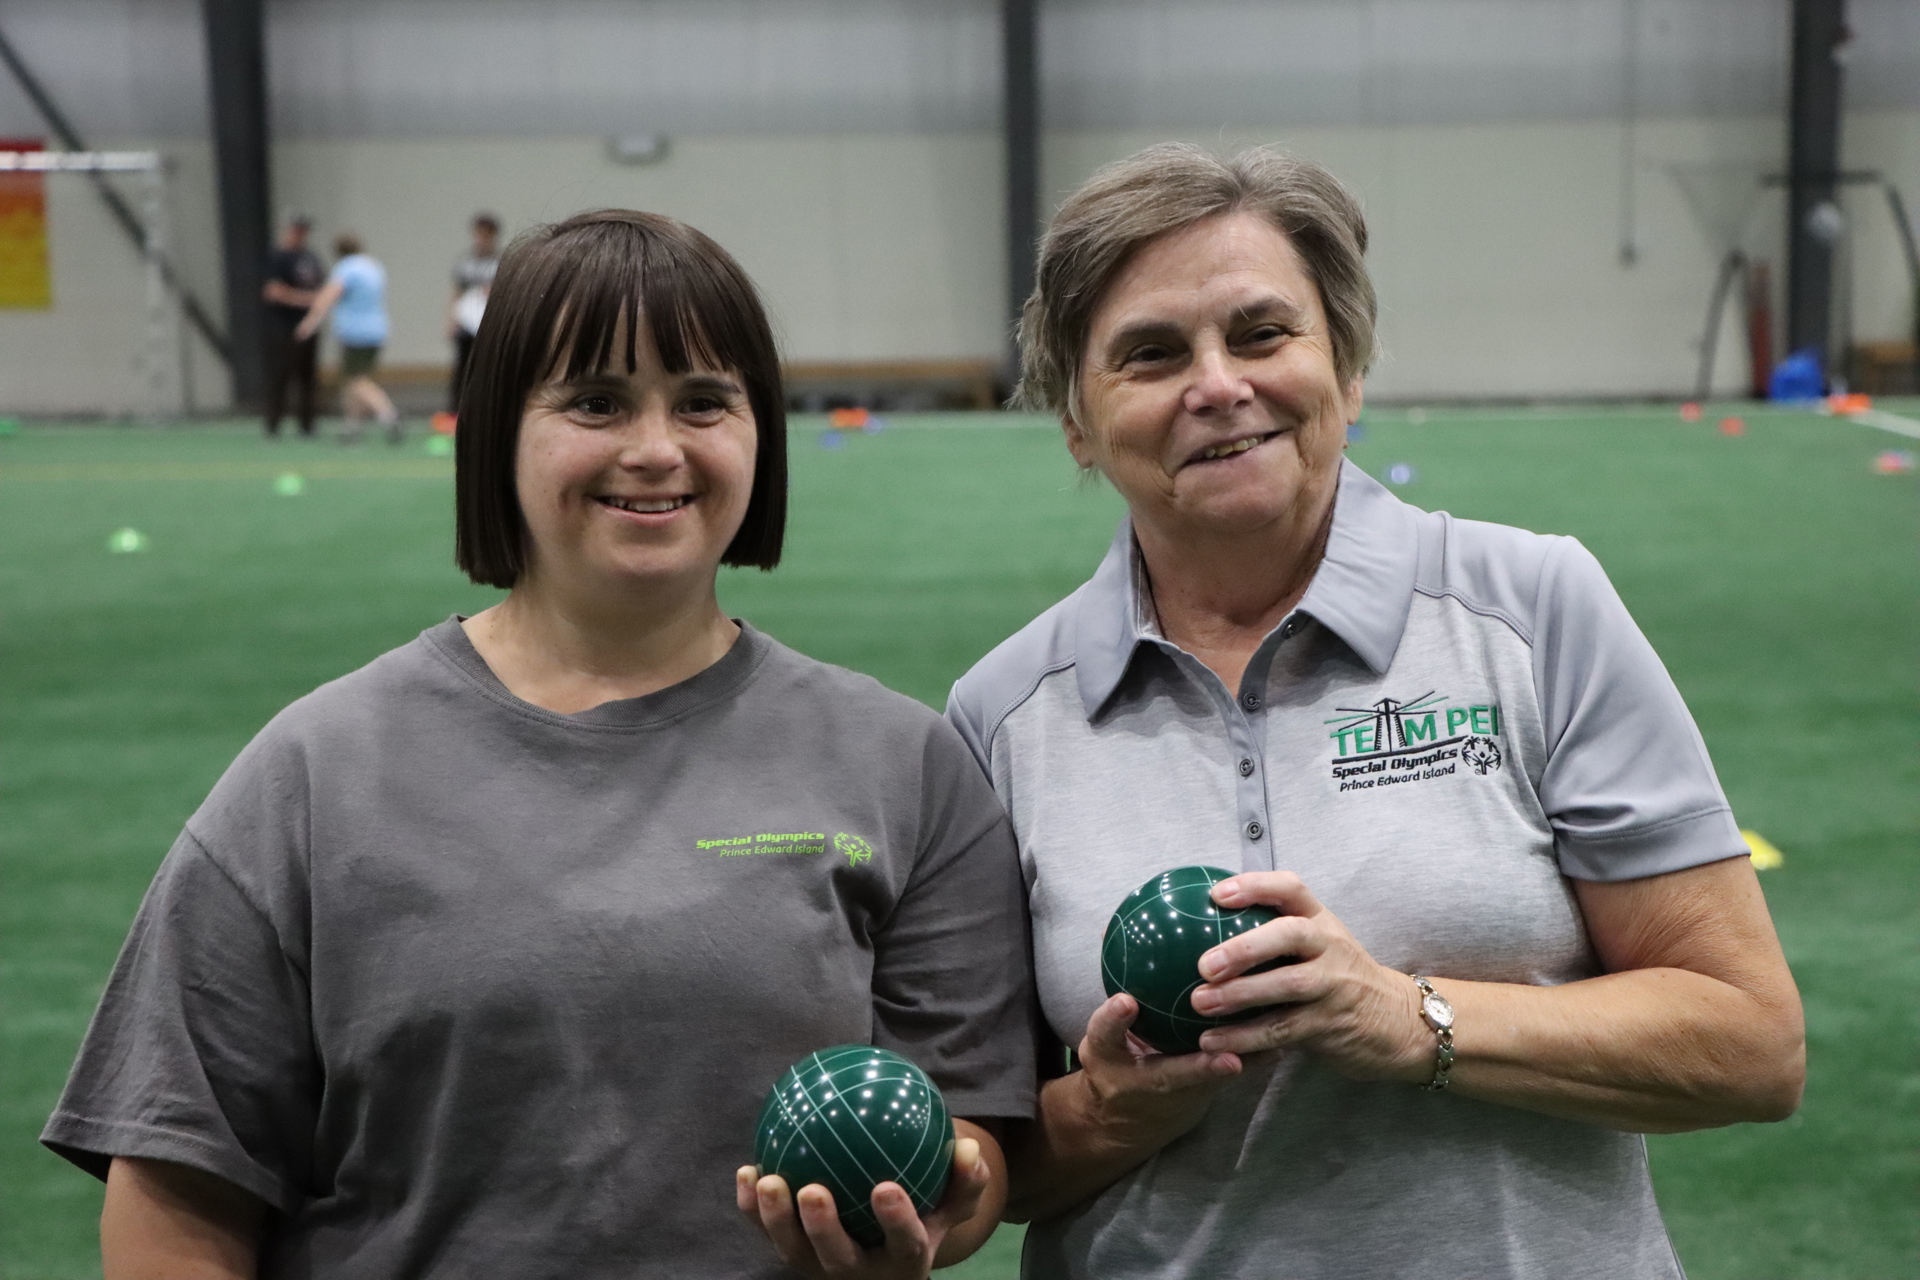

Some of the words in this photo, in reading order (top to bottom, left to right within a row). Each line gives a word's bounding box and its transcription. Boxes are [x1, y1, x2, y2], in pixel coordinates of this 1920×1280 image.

[1446, 705, 1499, 737] PEI
[1331, 759, 1387, 780] Special
[1390, 749, 1458, 771] Olympics
[1339, 777, 1375, 792] Prince
[1377, 771, 1420, 786] Edward
[1422, 763, 1456, 780] Island
[696, 836, 752, 850] Special
[755, 832, 825, 843] Olympics
[719, 847, 752, 858] Prince
[754, 844, 793, 855] Edward
[794, 843, 825, 854] Island
